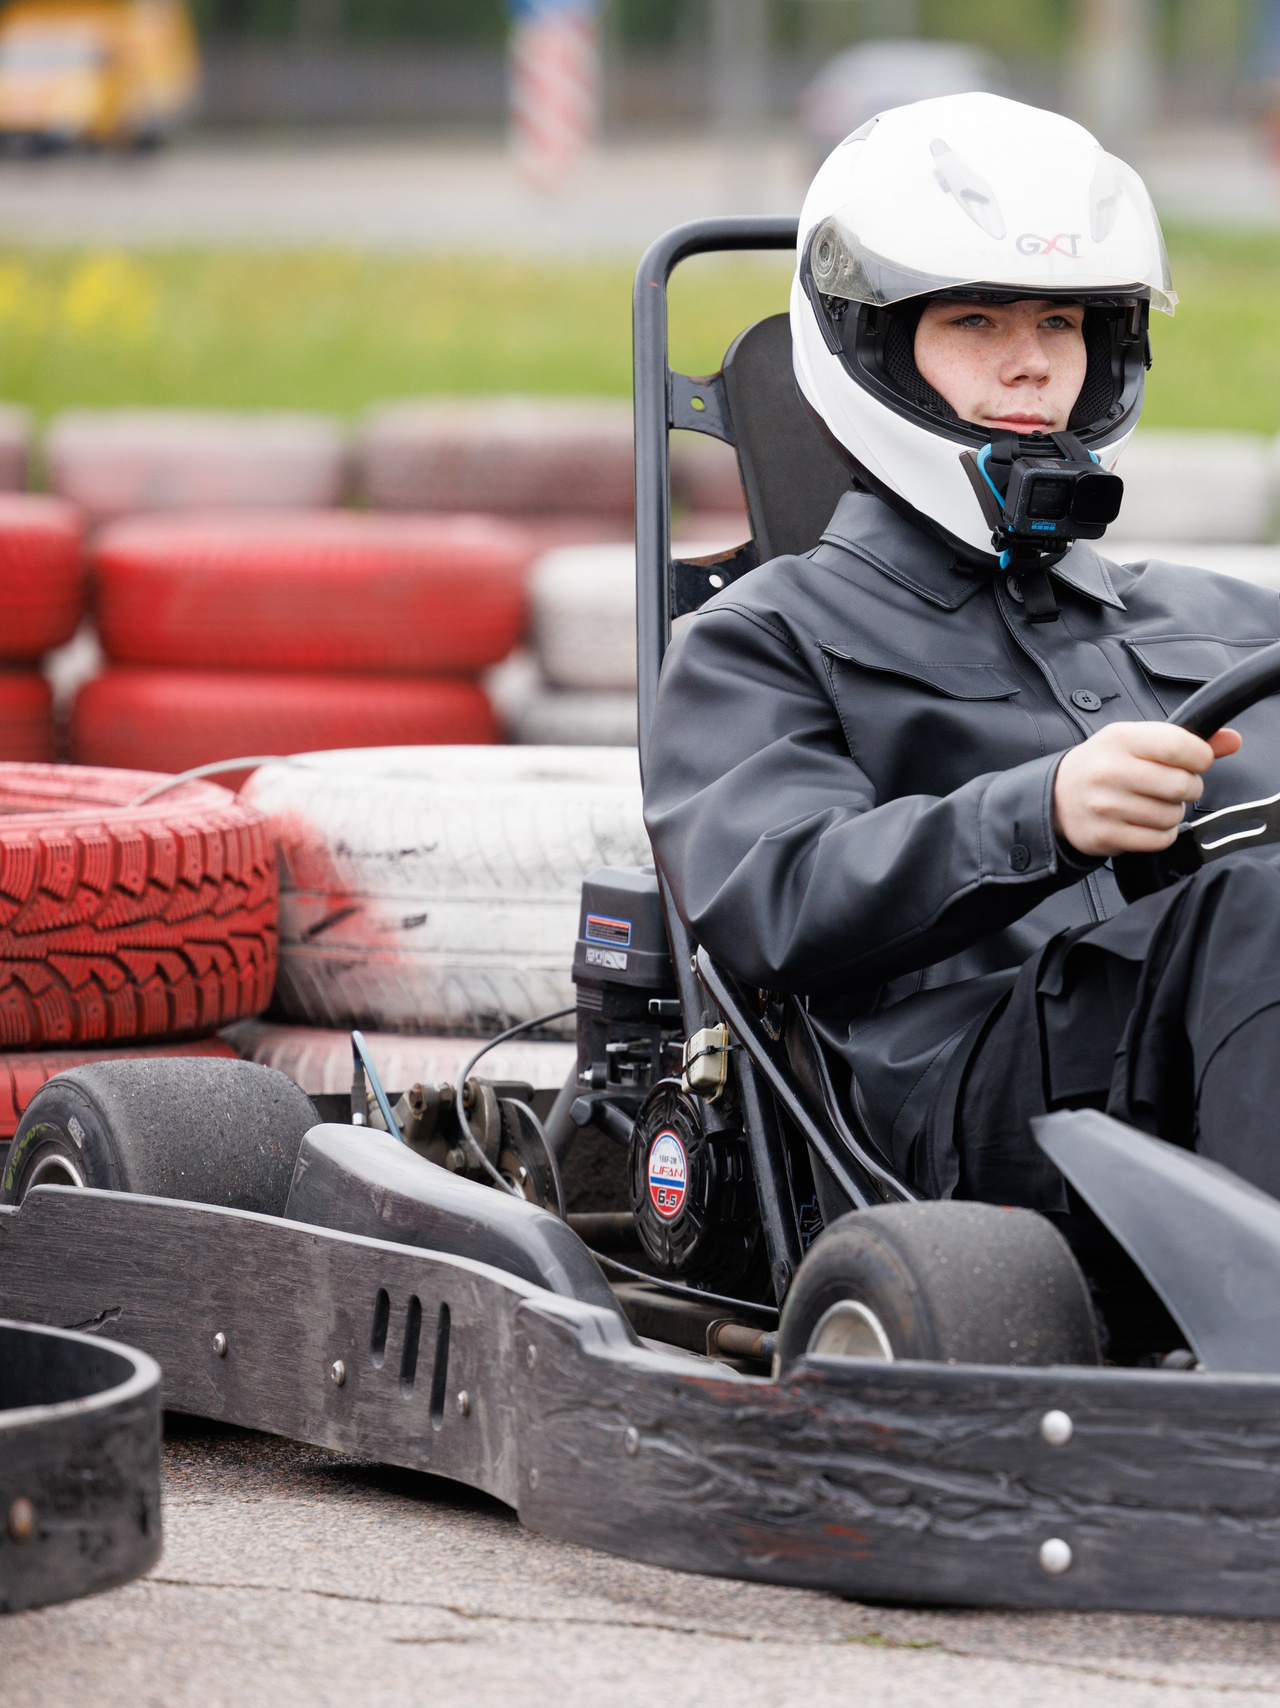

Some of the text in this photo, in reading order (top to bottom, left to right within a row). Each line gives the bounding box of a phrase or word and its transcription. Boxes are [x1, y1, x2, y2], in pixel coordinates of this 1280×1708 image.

[1016, 233, 1085, 259] GXT
[652, 1164, 683, 1178] LIFAN
[657, 1188, 677, 1207] 6.5
